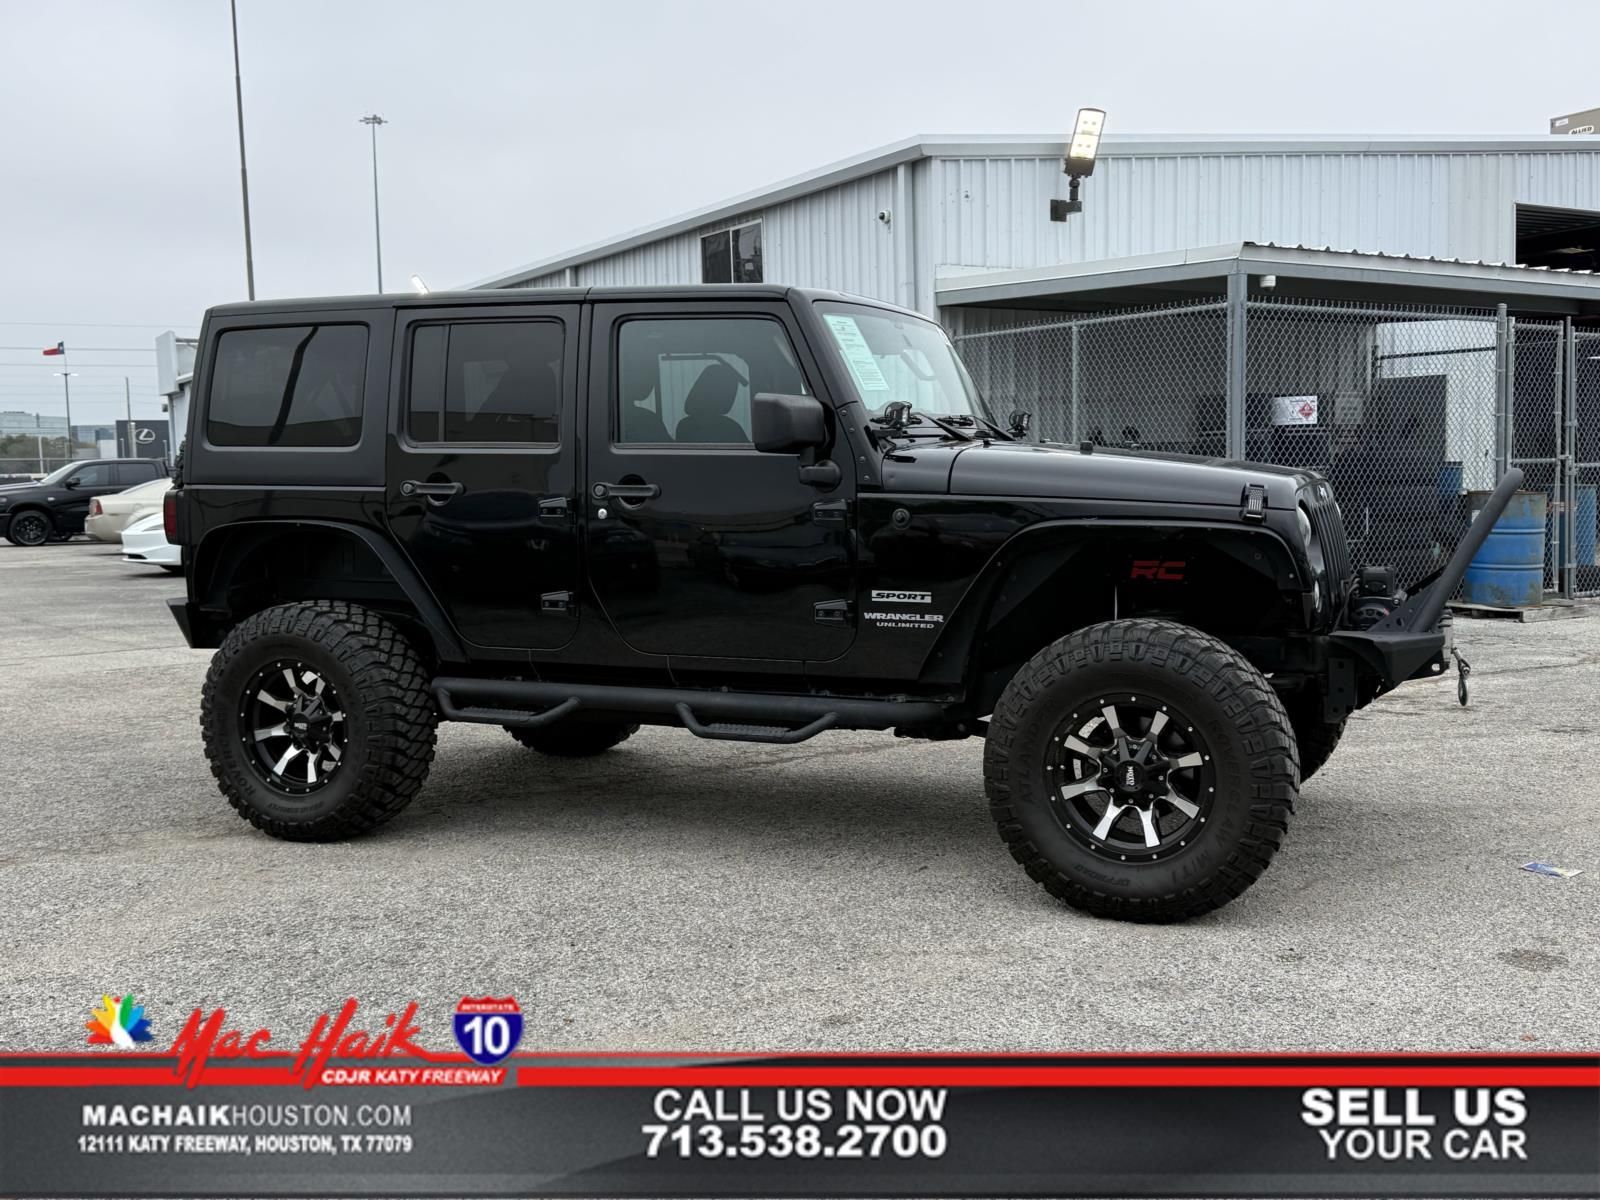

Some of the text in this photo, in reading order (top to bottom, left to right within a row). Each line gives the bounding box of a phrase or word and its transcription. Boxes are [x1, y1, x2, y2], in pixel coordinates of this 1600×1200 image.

[1571, 126, 1593, 135] ALLIED
[1130, 560, 1185, 580] RC
[874, 592, 929, 602] SPORT
[864, 612, 944, 622] WRANGLER
